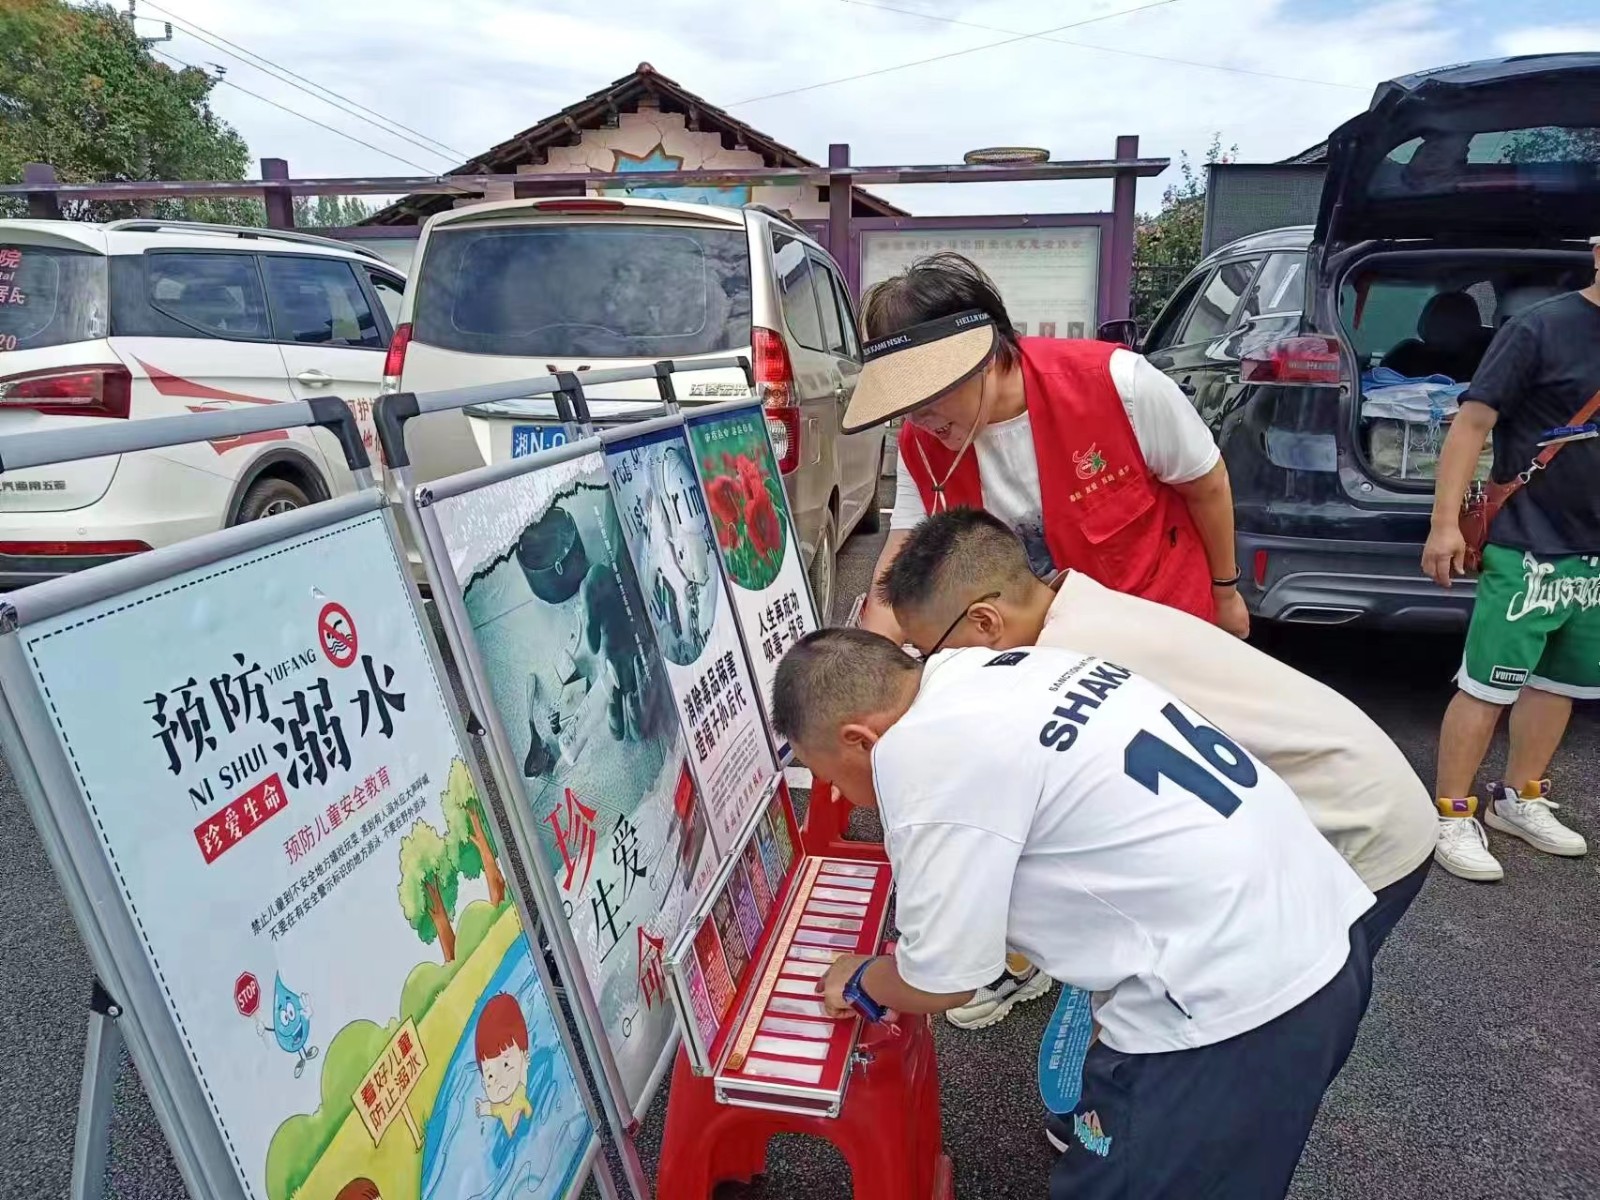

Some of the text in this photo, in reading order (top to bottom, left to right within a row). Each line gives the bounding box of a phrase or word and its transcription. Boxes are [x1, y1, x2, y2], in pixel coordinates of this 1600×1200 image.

[757, 588, 800, 638] 人生再成功
[762, 614, 807, 664] 吸毒一场空
[264, 649, 317, 686] YUFANG
[683, 650, 738, 729] 消除毒品祸害
[143, 653, 406, 790] 预防溺水
[694, 683, 748, 764] 造福子孙后代
[188, 744, 268, 811] NI SHUI
[1124, 702, 1258, 819] 16
[202, 784, 282, 855] 珍爱生命
[282, 765, 391, 865] 预防儿童安全教育
[237, 980, 258, 1011] STOP
[360, 1031, 414, 1107] 看好儿童
[368, 1053, 421, 1132] 防止溺水
